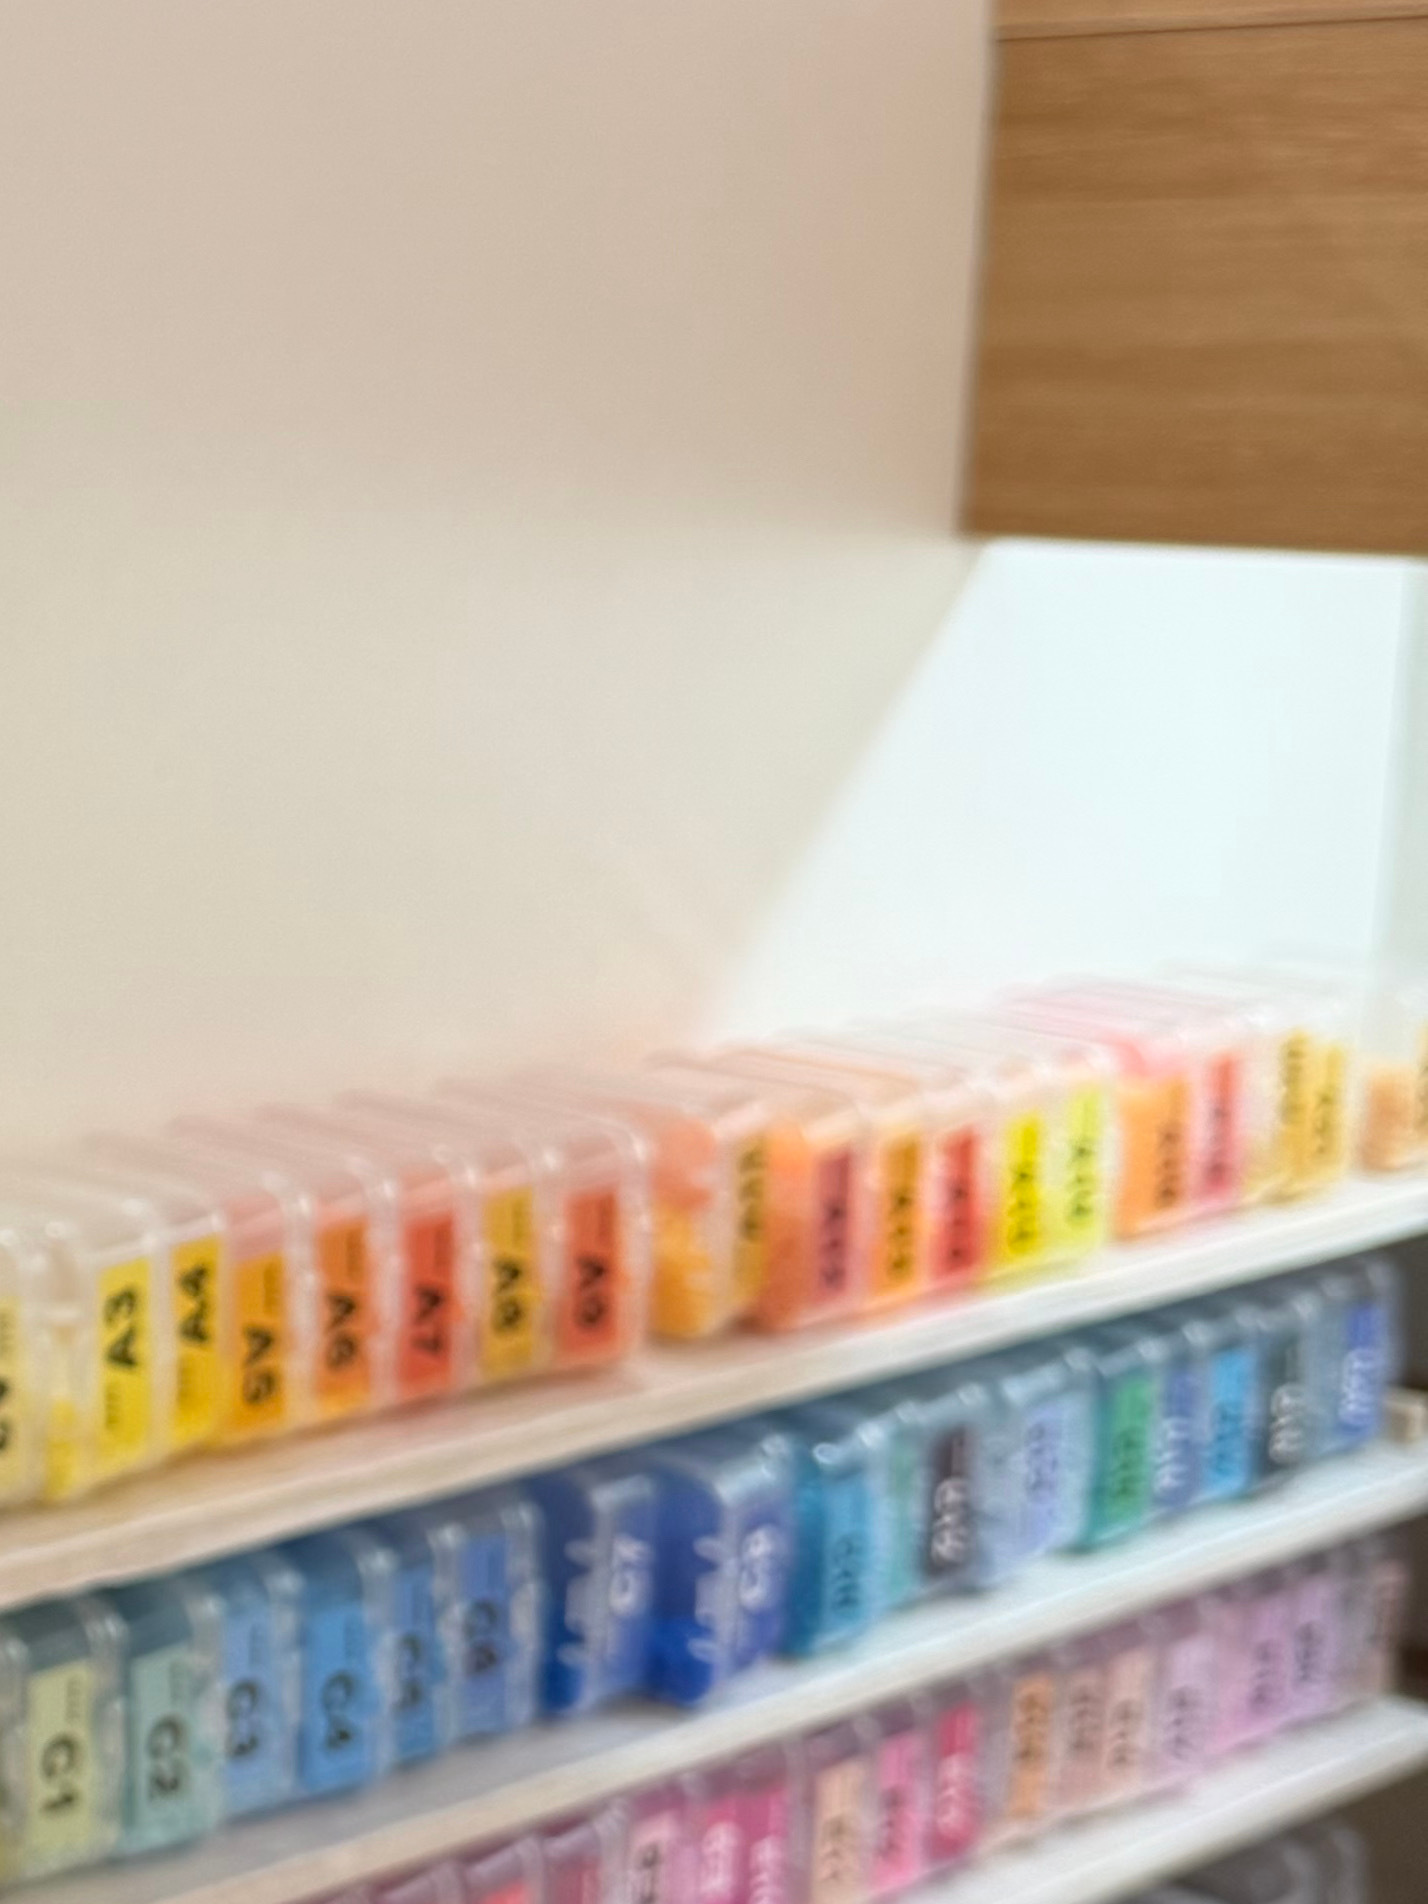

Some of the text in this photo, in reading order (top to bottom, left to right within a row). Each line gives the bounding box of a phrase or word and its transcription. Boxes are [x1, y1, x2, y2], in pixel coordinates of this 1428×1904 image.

[102, 1283, 141, 1370] A3
[177, 1264, 212, 1345] A4
[243, 1325, 278, 1407] A5
